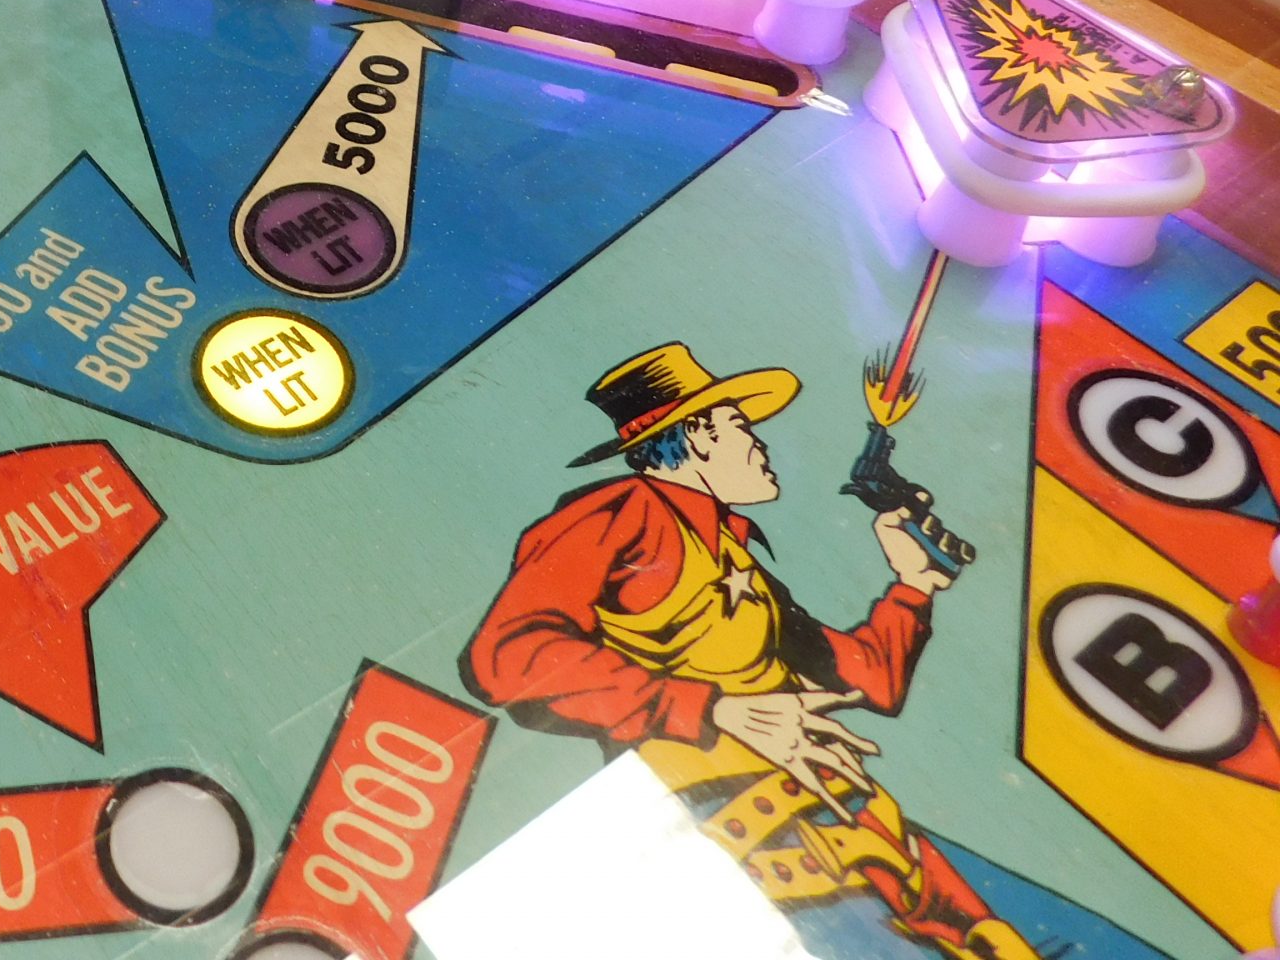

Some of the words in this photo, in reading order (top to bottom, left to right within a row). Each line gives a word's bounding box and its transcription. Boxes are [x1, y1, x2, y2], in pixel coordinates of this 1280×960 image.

[321, 54, 410, 176] 5000
[17, 227, 86, 291] and
[262, 197, 360, 257] WHEN
[310, 235, 363, 278] LIT
[46, 268, 127, 341] ADD
[75, 275, 196, 393] BONUS
[209, 326, 317, 391] WHEN
[262, 371, 319, 417] LIT
[1106, 395, 1215, 478] C
[1072, 612, 1213, 732] B
[302, 720, 454, 924] 9000
